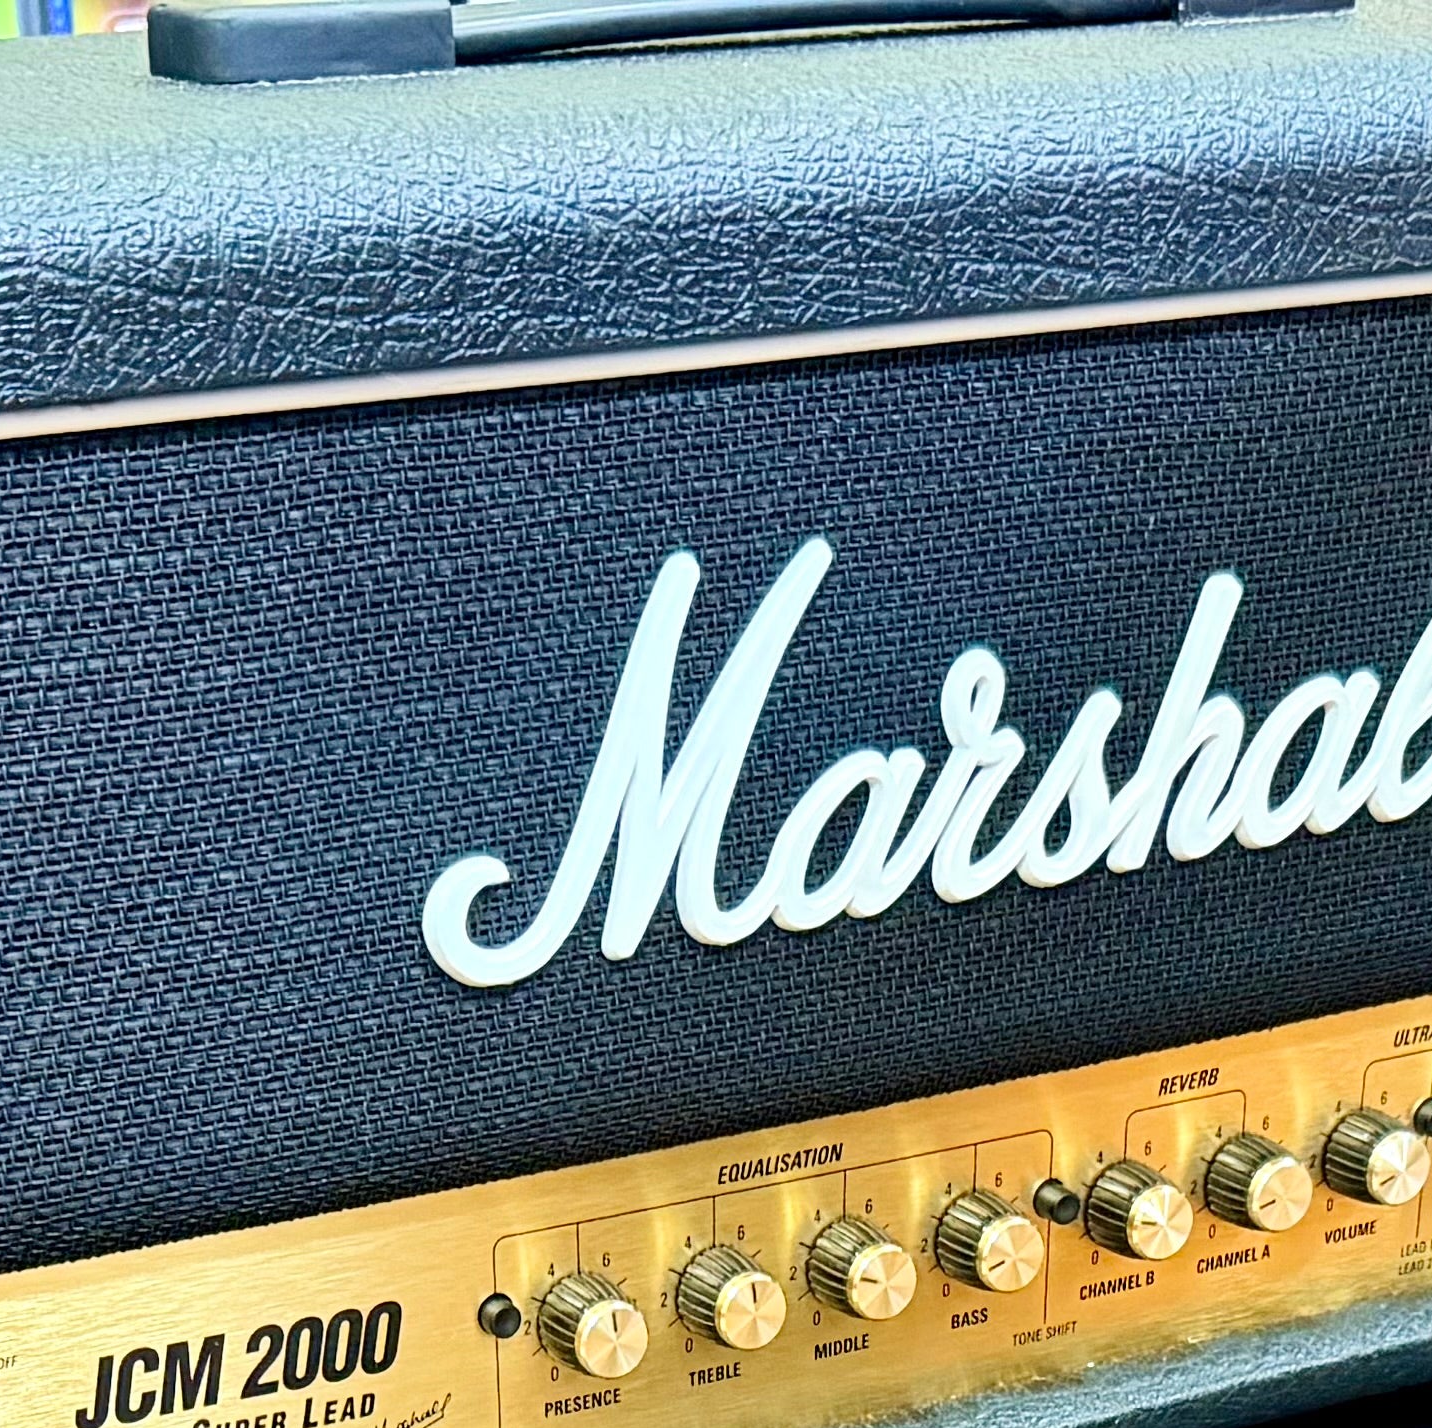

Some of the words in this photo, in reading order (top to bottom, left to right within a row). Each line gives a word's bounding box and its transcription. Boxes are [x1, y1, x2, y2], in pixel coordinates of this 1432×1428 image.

[1158, 1067, 1220, 1097] REVERB
[1380, 1090, 1388, 1105] 6
[1262, 1115, 1270, 1131] 6
[1215, 1125, 1223, 1139] 4
[1144, 1140, 1152, 1156] 6
[717, 1142, 844, 1185] EQUALISATION
[1096, 1150, 1104, 1164] 4
[994, 1172, 1003, 1188] 6
[1190, 1180, 1198, 1196] 2
[944, 1182, 952, 1196] 4
[864, 1198, 873, 1215] 6
[1326, 1198, 1334, 1212] 0
[813, 1209, 821, 1223] 4
[737, 1225, 745, 1241] 6
[1208, 1224, 1216, 1239] 0
[1324, 1219, 1378, 1245] VOLUME
[684, 1235, 692, 1250] 4
[920, 1238, 928, 1254] 2
[1400, 1239, 1426, 1258] LEAD
[602, 1251, 611, 1268] 6
[1091, 1250, 1099, 1266] 0
[1196, 1246, 1258, 1274] CHANNEL
[1260, 1245, 1271, 1260] A
[547, 1262, 555, 1278] 4
[789, 1265, 798, 1281] 2
[1398, 1259, 1425, 1276] LEAD
[942, 1283, 951, 1298] 0
[1079, 1272, 1142, 1301] CHANNEL
[1145, 1270, 1155, 1286] B
[660, 1292, 668, 1308] 2
[813, 1310, 821, 1326] 0
[950, 1307, 989, 1330] BASS
[524, 1320, 532, 1336] 2
[1012, 1328, 1043, 1347] TONE
[1045, 1320, 1078, 1340] SHIFT
[240, 1300, 403, 1400] 2000
[684, 1337, 693, 1353] 0
[814, 1333, 870, 1361] MIDDLE
[550, 1365, 560, 1382] 0
[688, 1361, 742, 1387] TREBLE
[544, 1388, 622, 1419] PRESENCE
